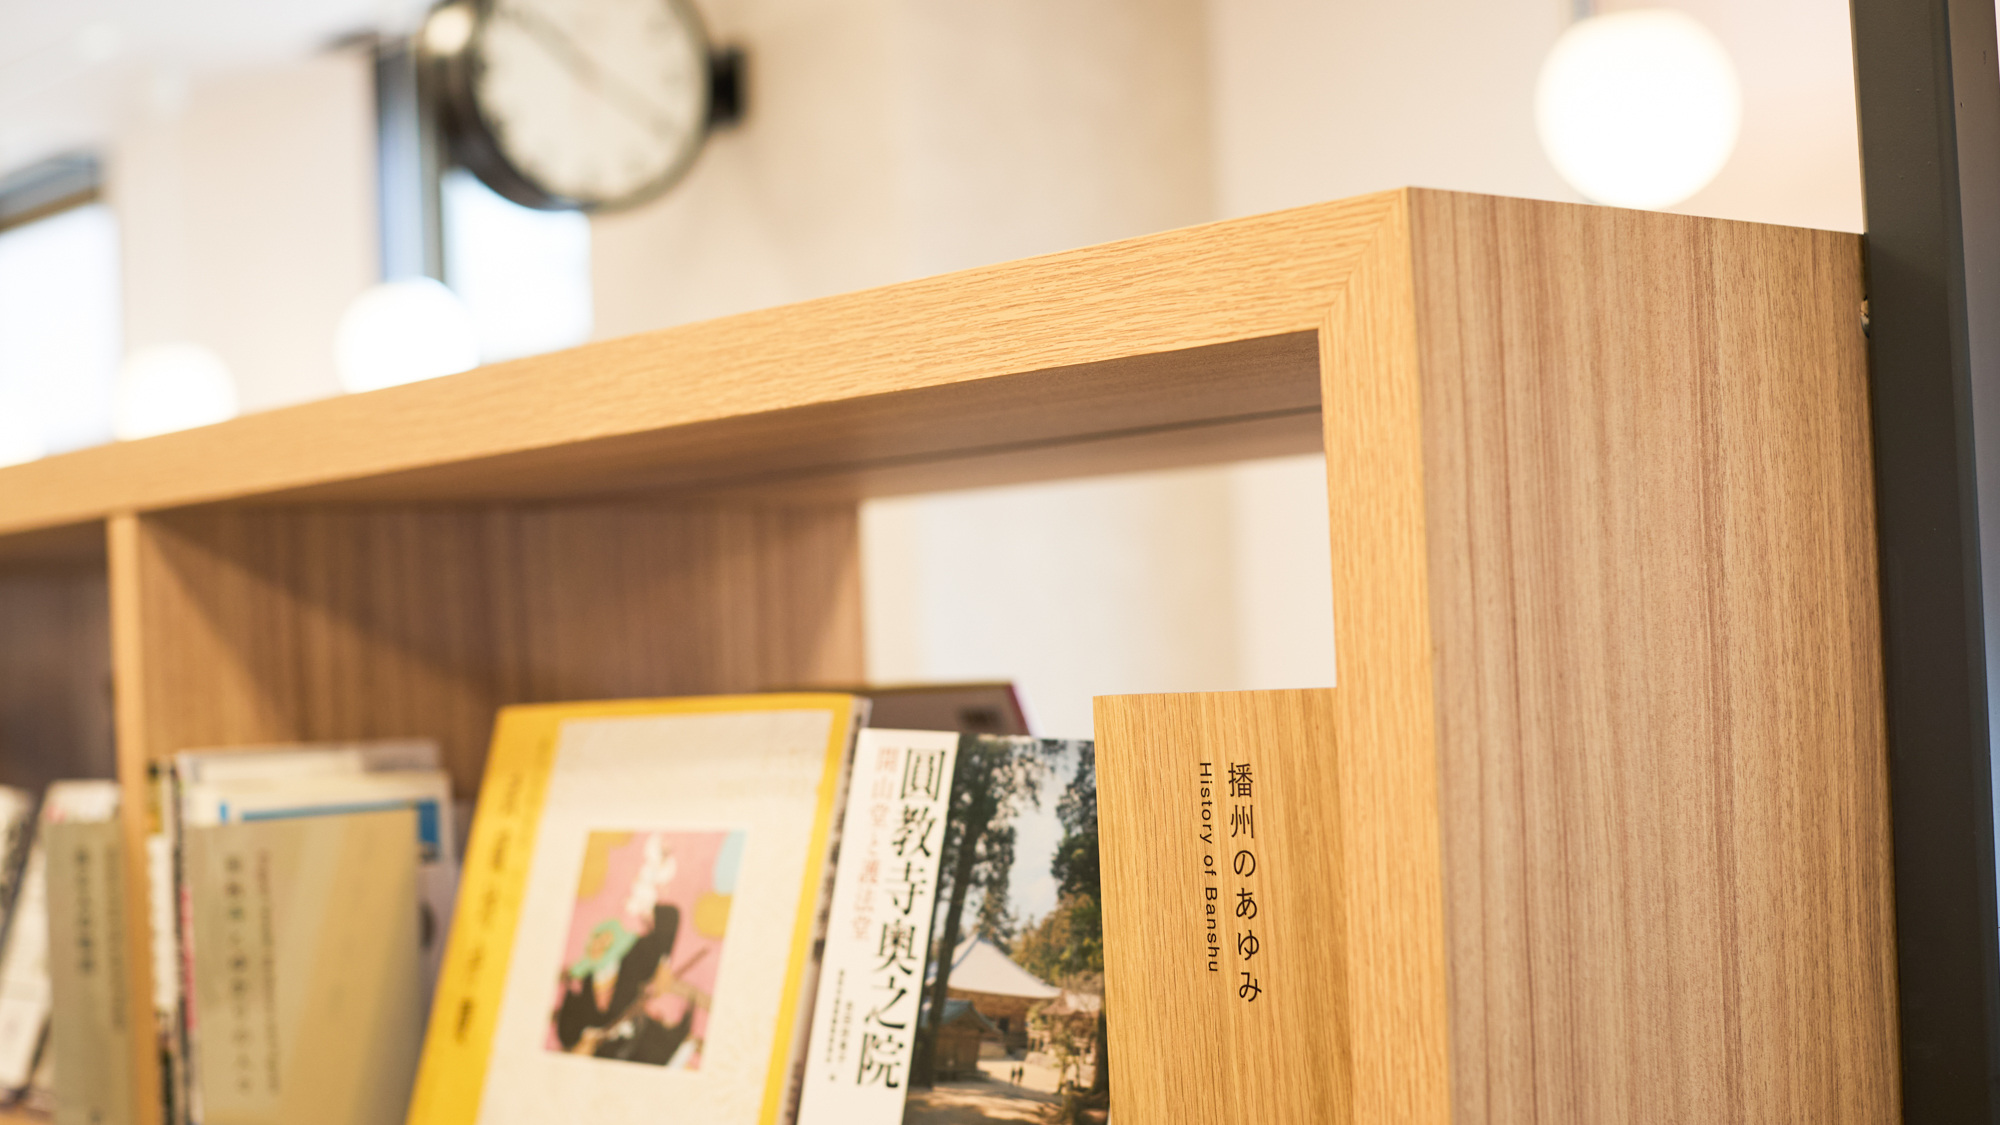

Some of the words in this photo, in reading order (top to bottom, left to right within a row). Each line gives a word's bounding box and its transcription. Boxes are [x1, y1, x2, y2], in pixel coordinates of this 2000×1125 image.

[1199, 762, 1213, 844] History
[1203, 854, 1217, 877] of
[1228, 762, 1262, 1003] 播州のあゆみ
[857, 748, 946, 1088] 圓教寺奥之院
[1205, 887, 1220, 973] Banshu
